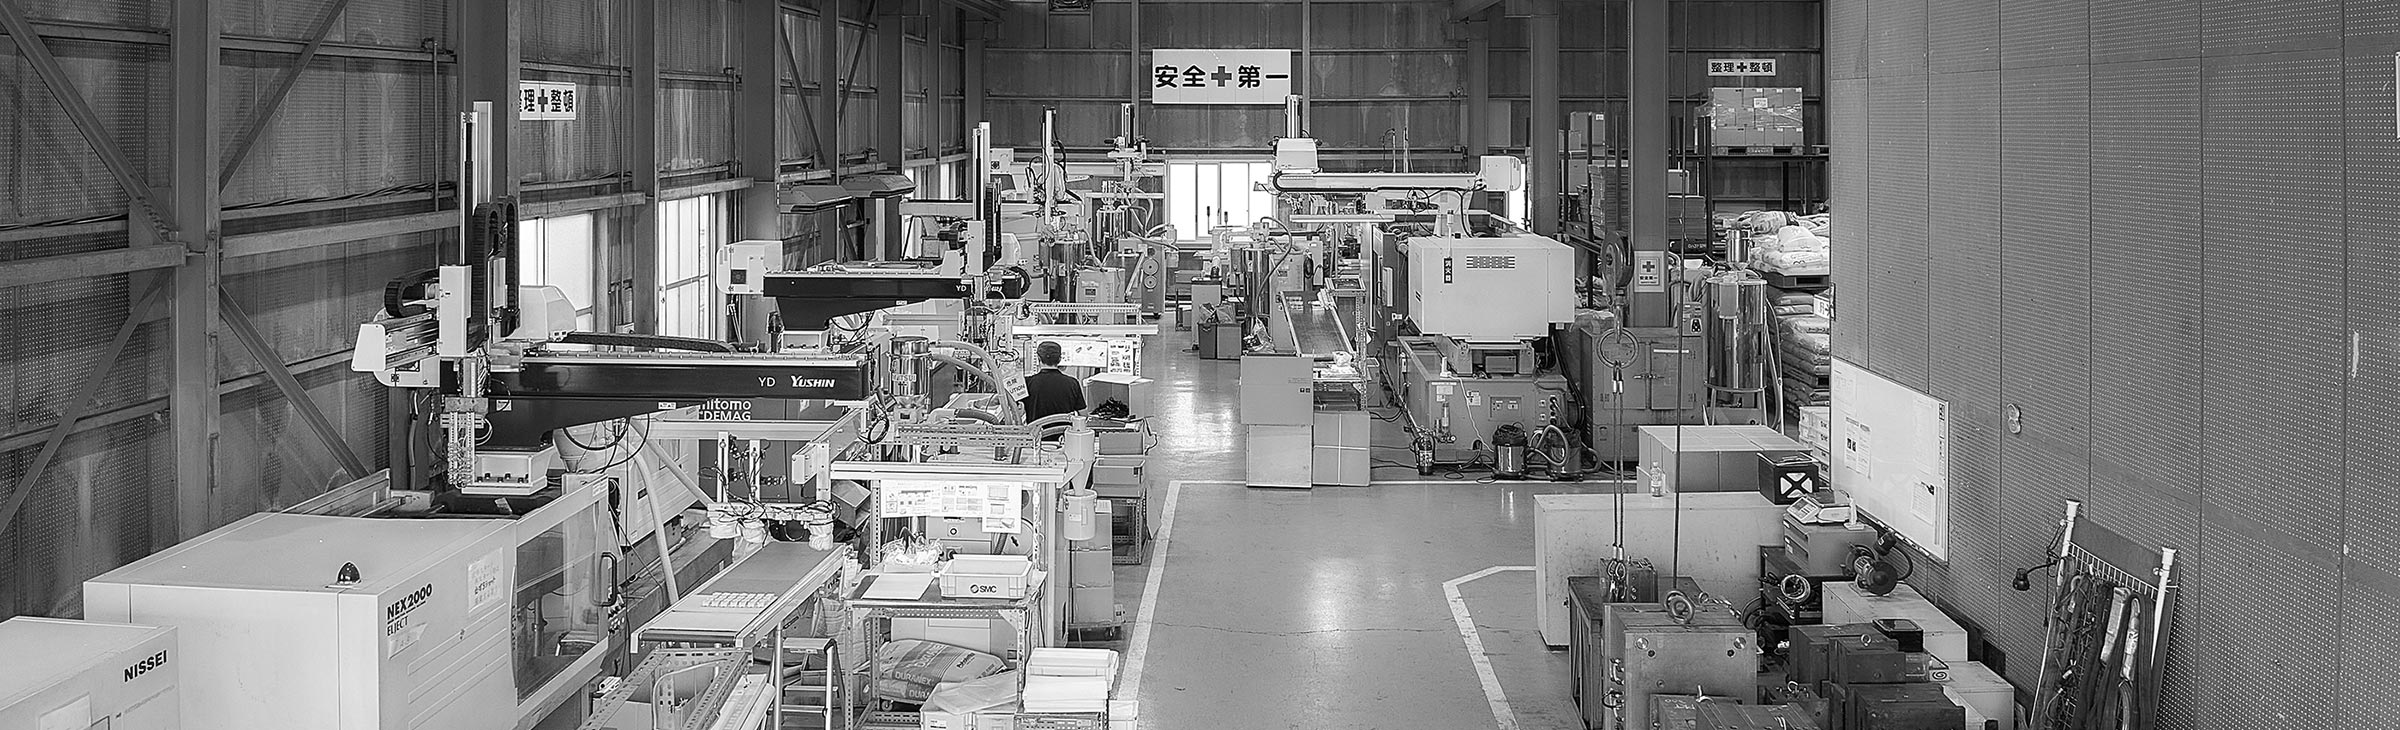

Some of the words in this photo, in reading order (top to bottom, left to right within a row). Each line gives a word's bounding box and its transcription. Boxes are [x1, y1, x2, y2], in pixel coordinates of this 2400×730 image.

[1155, 64, 1206, 88] 安全
[1238, 64, 1289, 88] 第一
[520, 89, 535, 112] 理
[550, 88, 574, 112] 整頓
[758, 376, 776, 387] YD
[700, 410, 751, 421] DEMAG
[980, 585, 997, 593] SMC
[387, 583, 433, 620] NEX2000
[124, 650, 167, 682] NISSEI
